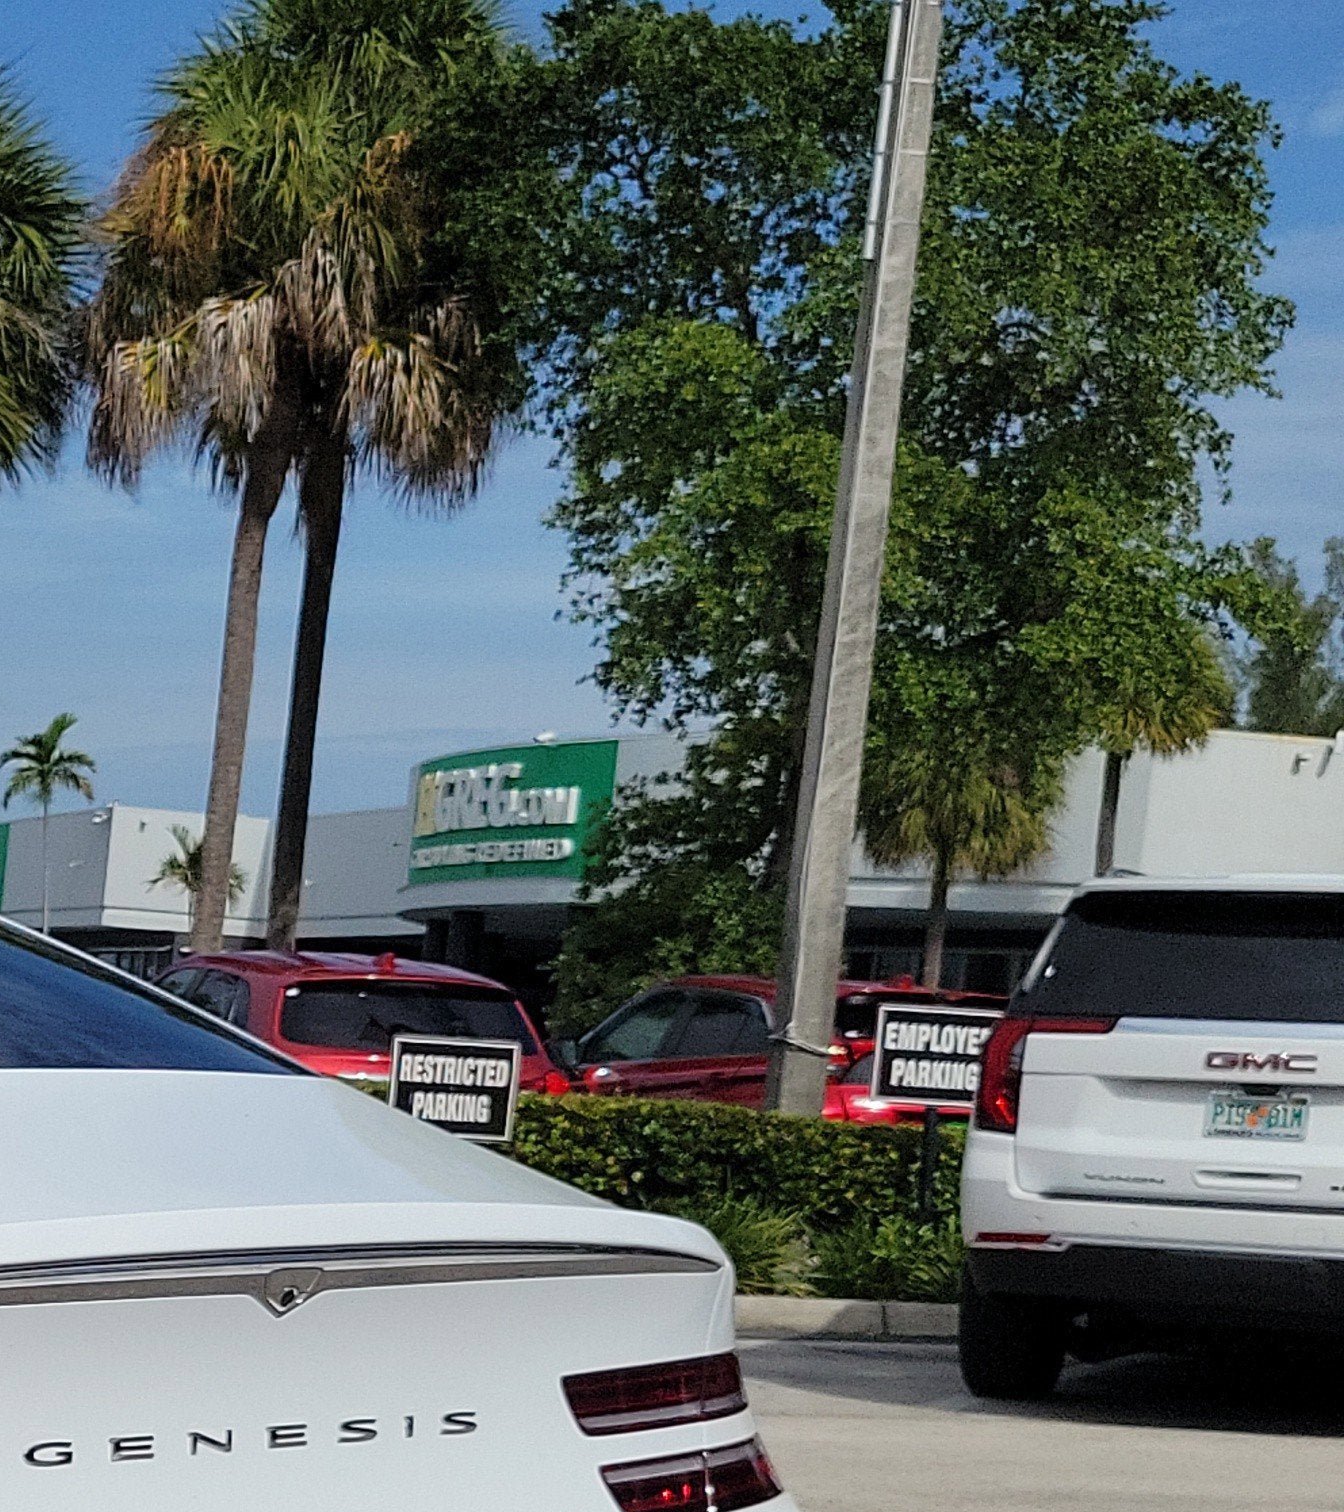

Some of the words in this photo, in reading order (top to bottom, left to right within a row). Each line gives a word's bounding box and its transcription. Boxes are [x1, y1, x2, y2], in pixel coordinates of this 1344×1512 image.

[400, 1053, 511, 1088] RESTRICTED
[889, 1057, 983, 1091] PARKING
[1205, 1052, 1318, 1073] GMC
[412, 1091, 493, 1123] PARKING
[22, 1411, 478, 1467] GENESIS
